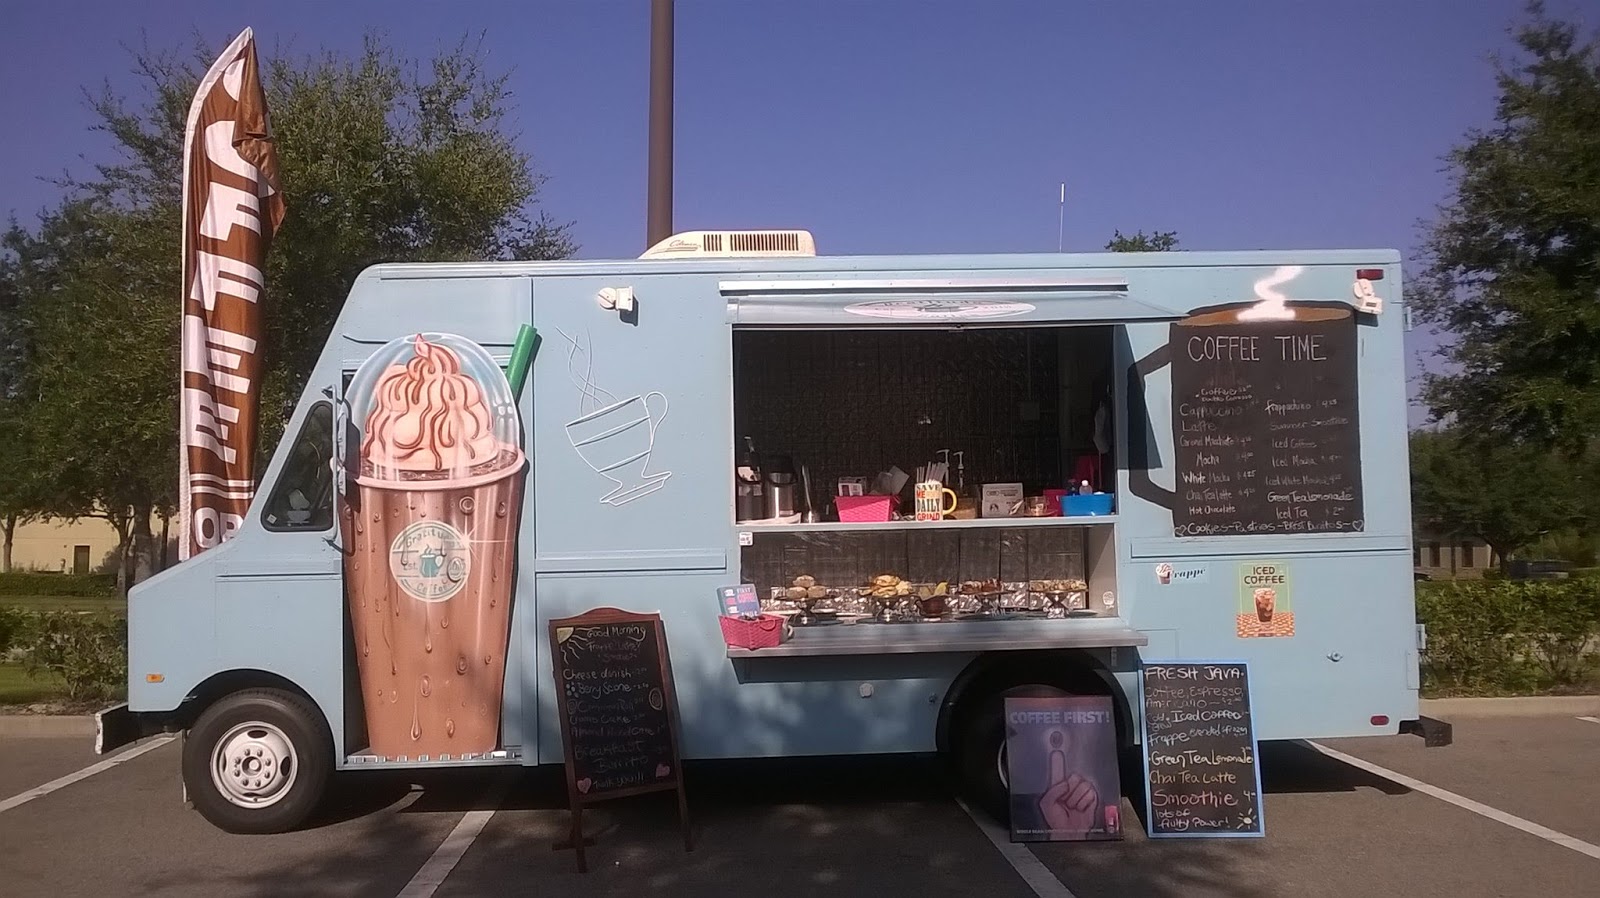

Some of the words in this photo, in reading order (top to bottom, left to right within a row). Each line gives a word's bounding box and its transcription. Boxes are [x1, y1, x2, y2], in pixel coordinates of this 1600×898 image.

[1187, 336, 1260, 361] COFFEE
[1274, 335, 1327, 361] TIME
[916, 498, 941, 512] DAILY
[916, 512, 941, 521] GRIND
[1253, 566, 1276, 575] ICED
[1244, 575, 1285, 585] COFFEE
[586, 626, 609, 638] Good
[611, 624, 647, 641] Morning
[563, 668, 597, 680] Cheese
[600, 667, 632, 679] danish
[1145, 666, 1199, 680] FRESH
[602, 682, 632, 695] Scone
[1009, 711, 1061, 724] COFFEE
[1063, 711, 1110, 724] FIRST!
[1170, 710, 1200, 722] Iced
[1148, 732, 1190, 746] Frappe
[1151, 750, 1186, 768] Green
[1183, 749, 1212, 765] Tea
[1211, 748, 1254, 765] Lemonade
[1149, 769, 1176, 784] Chai
[1178, 770, 1200, 783] Tea
[1202, 771, 1237, 784] Latte
[1152, 789, 1239, 807] Smoothie
